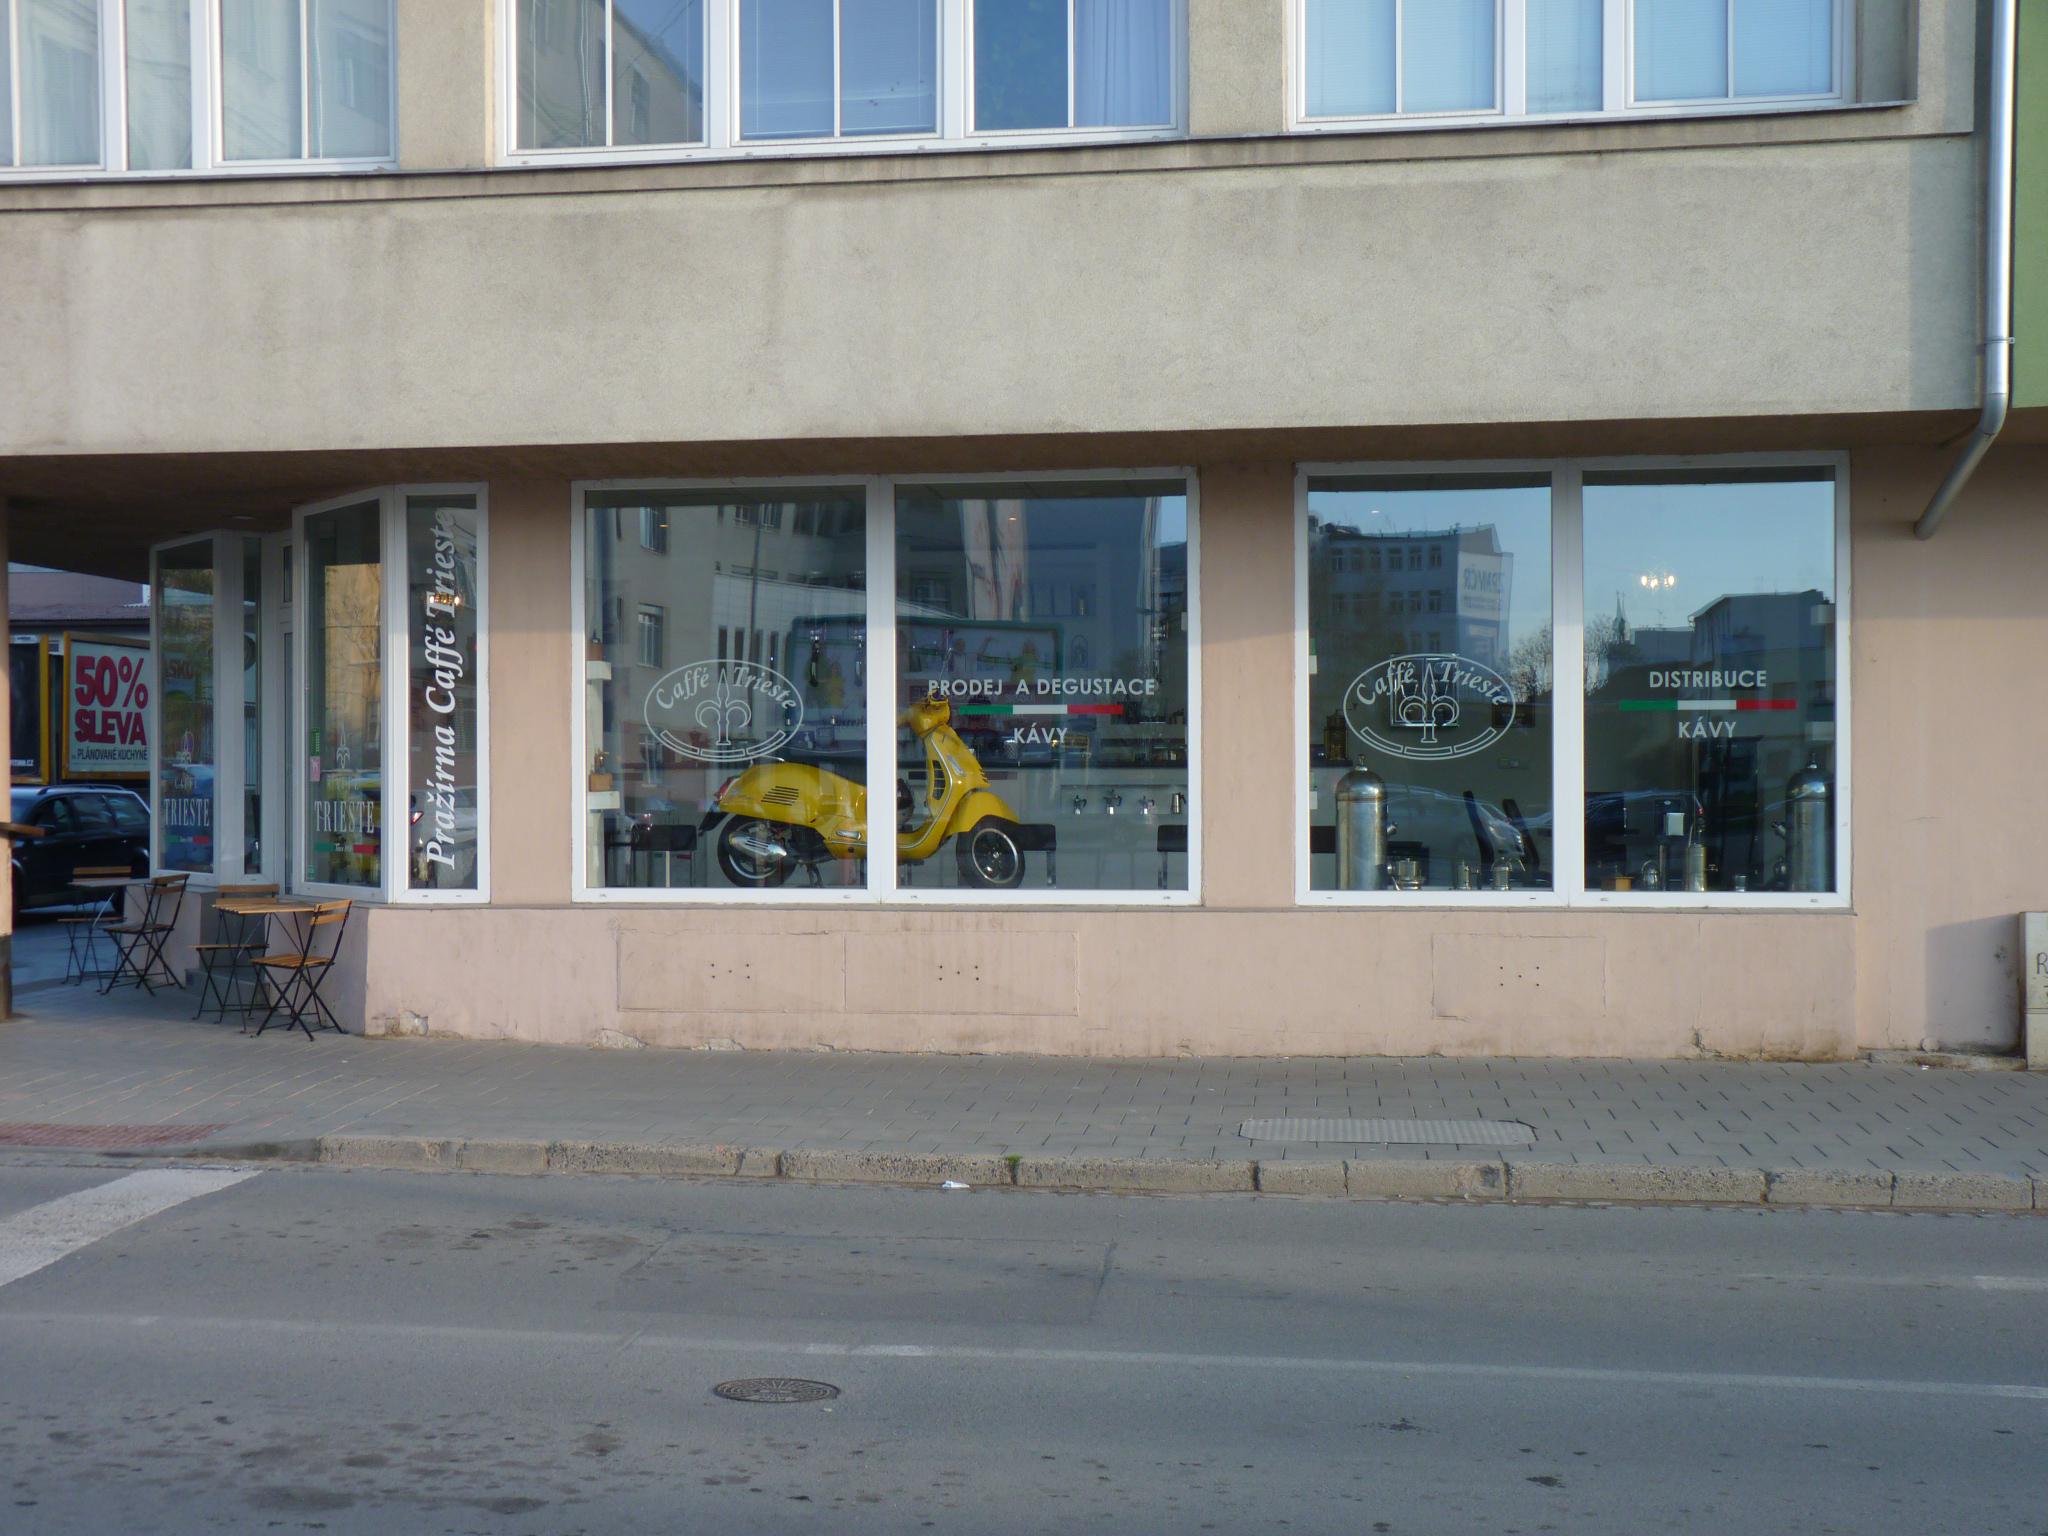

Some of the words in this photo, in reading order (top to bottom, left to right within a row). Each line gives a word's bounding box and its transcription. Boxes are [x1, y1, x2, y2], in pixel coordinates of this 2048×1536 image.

[426, 510, 456, 618] Trieste
[75, 655, 149, 709] 50%
[425, 624, 463, 713] Caffé
[656, 667, 710, 709] Caffé
[732, 666, 797, 709] Trieste
[928, 679, 1003, 697] PRODEJ
[1015, 679, 1031, 695] A
[1037, 678, 1156, 696] DEGUSTACE
[1440, 661, 1508, 705] Trieste
[1649, 670, 1767, 688] DISTRIBUCE
[75, 708, 148, 746] SLEVA
[1013, 722, 1069, 744] KÁVY
[1678, 716, 1737, 738] KÁVY
[163, 798, 210, 827] TRIESTE
[426, 725, 455, 870] Pražírna
[314, 800, 375, 834] TRIESTE
